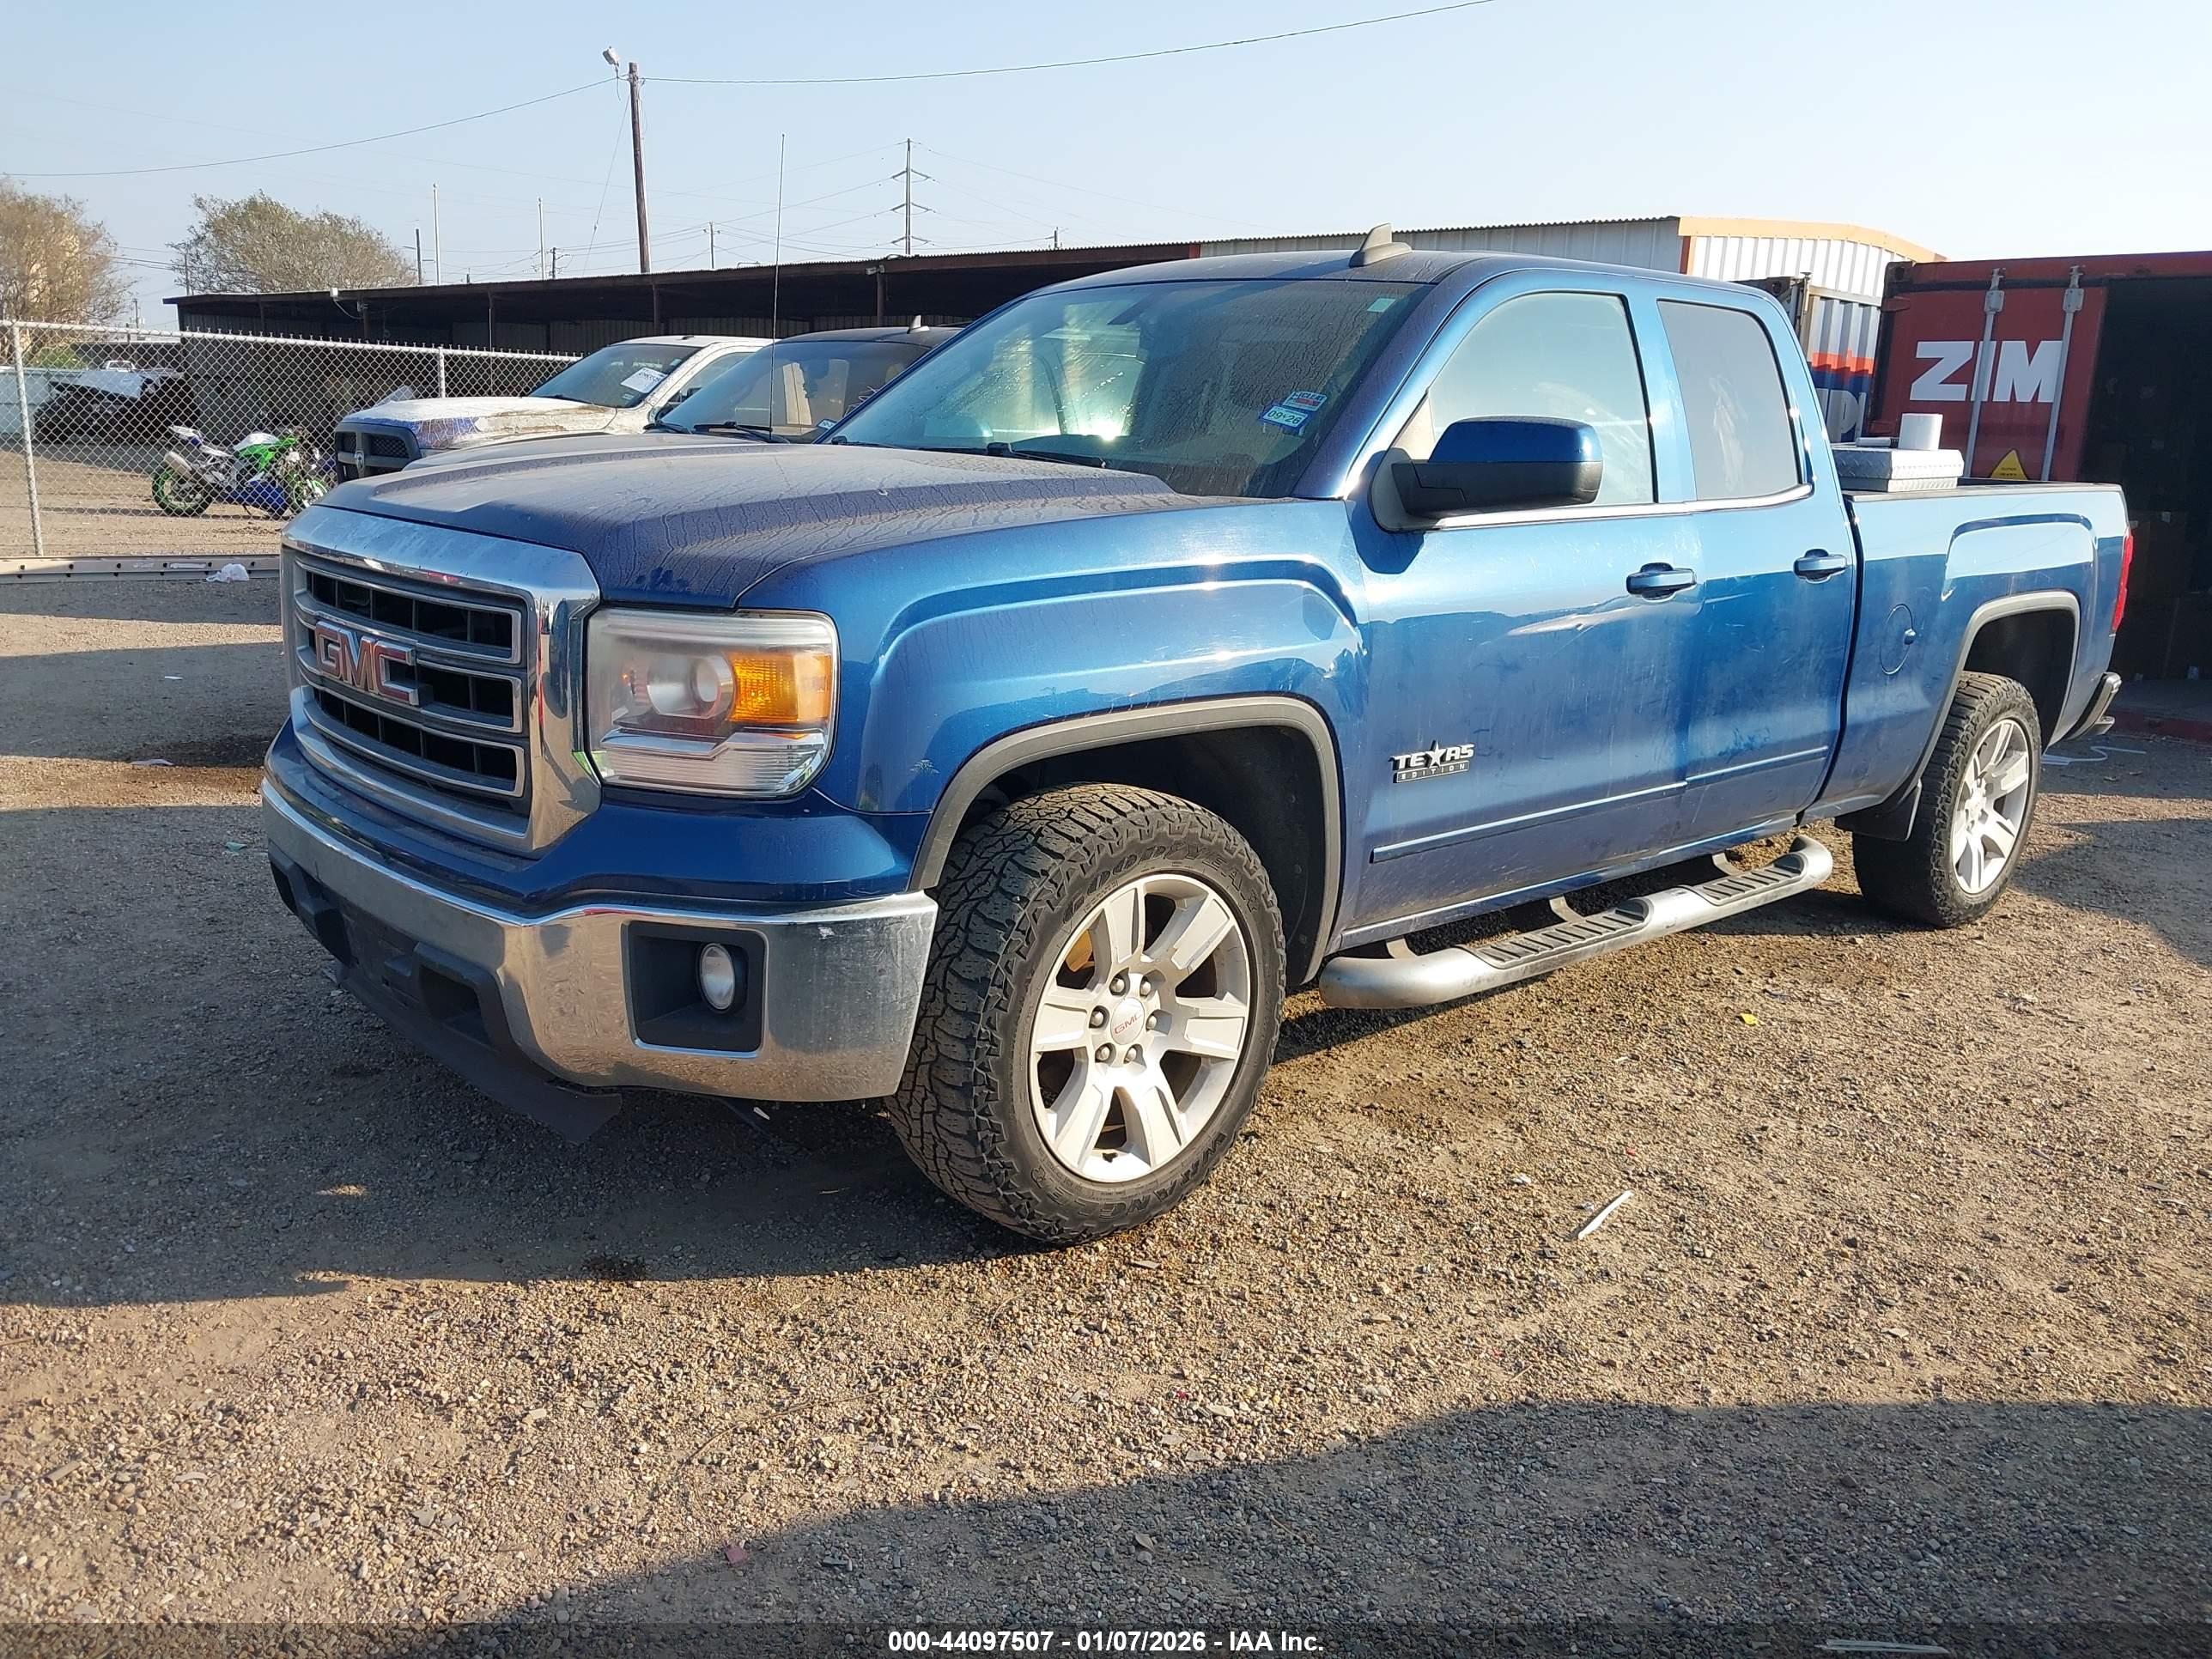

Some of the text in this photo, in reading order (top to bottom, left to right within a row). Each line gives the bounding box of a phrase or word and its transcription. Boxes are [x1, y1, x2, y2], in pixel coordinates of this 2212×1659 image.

[1910, 341, 2063, 403] ZIM
[1285, 415, 1302, 424] 26
[315, 621, 419, 706] GMC
[1392, 738, 1475, 769] TEXAS
[1401, 763, 1466, 780] EDITION
[1062, 840, 1259, 924] GOODYEAR
[1030, 1132, 1227, 1219] WRANGLER
